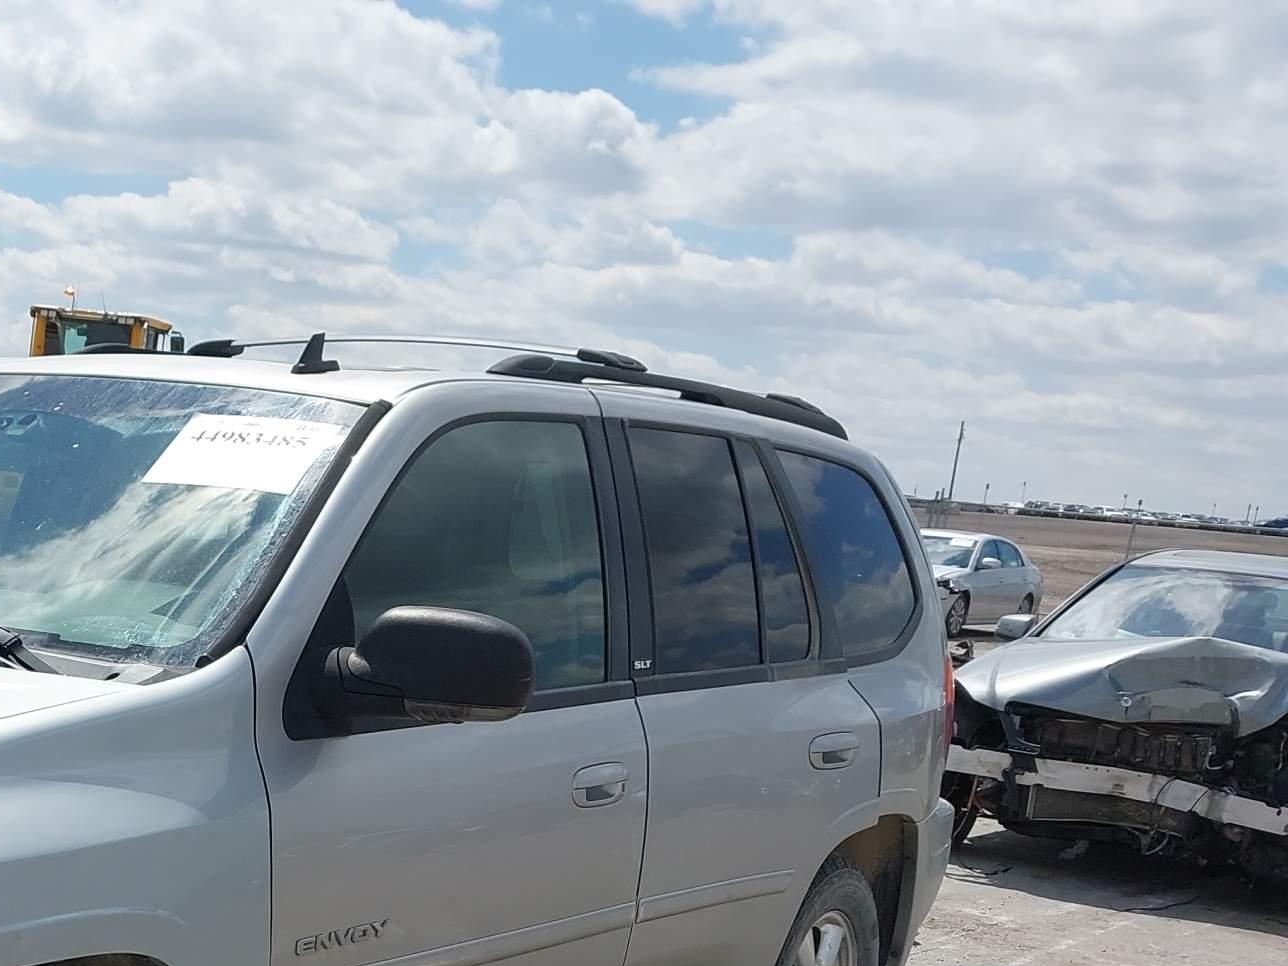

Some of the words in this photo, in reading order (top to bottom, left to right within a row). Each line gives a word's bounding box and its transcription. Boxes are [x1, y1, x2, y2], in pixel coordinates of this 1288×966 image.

[191, 429, 312, 448] 44983485
[634, 660, 652, 670] SLT
[295, 918, 390, 956] ENVOY
